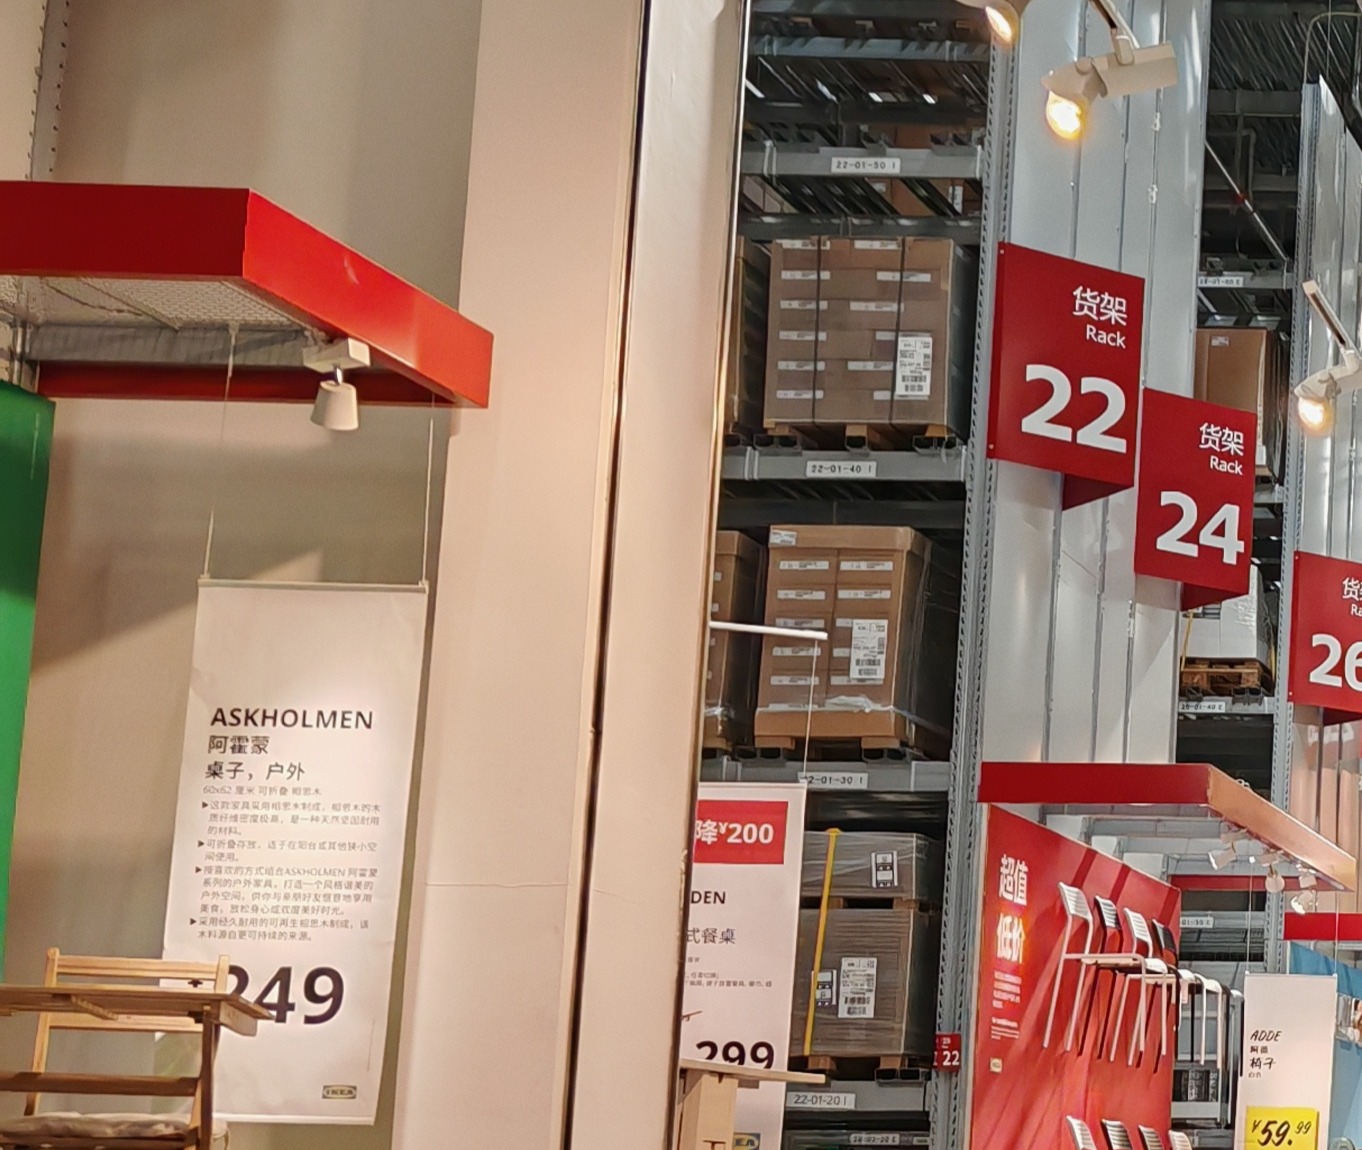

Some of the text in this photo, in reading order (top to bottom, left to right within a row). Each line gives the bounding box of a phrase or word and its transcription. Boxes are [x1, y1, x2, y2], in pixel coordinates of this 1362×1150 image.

[1072, 284, 1127, 326] 货架
[1086, 324, 1126, 349] Rack
[1021, 363, 1127, 454] 22
[1199, 422, 1245, 457] 货架
[1210, 455, 1243, 476] Rack
[1156, 490, 1245, 566] 24
[210, 707, 373, 729] ASKHOLMEN
[207, 734, 270, 755] 阿霍蒙
[998, 853, 1029, 906] 超值
[996, 911, 1027, 965] 低价
[1250, 1029, 1283, 1043] ADDE
[943, 1050, 959, 1067] 22
[794, 1093, 841, 1106] 22-01-20
